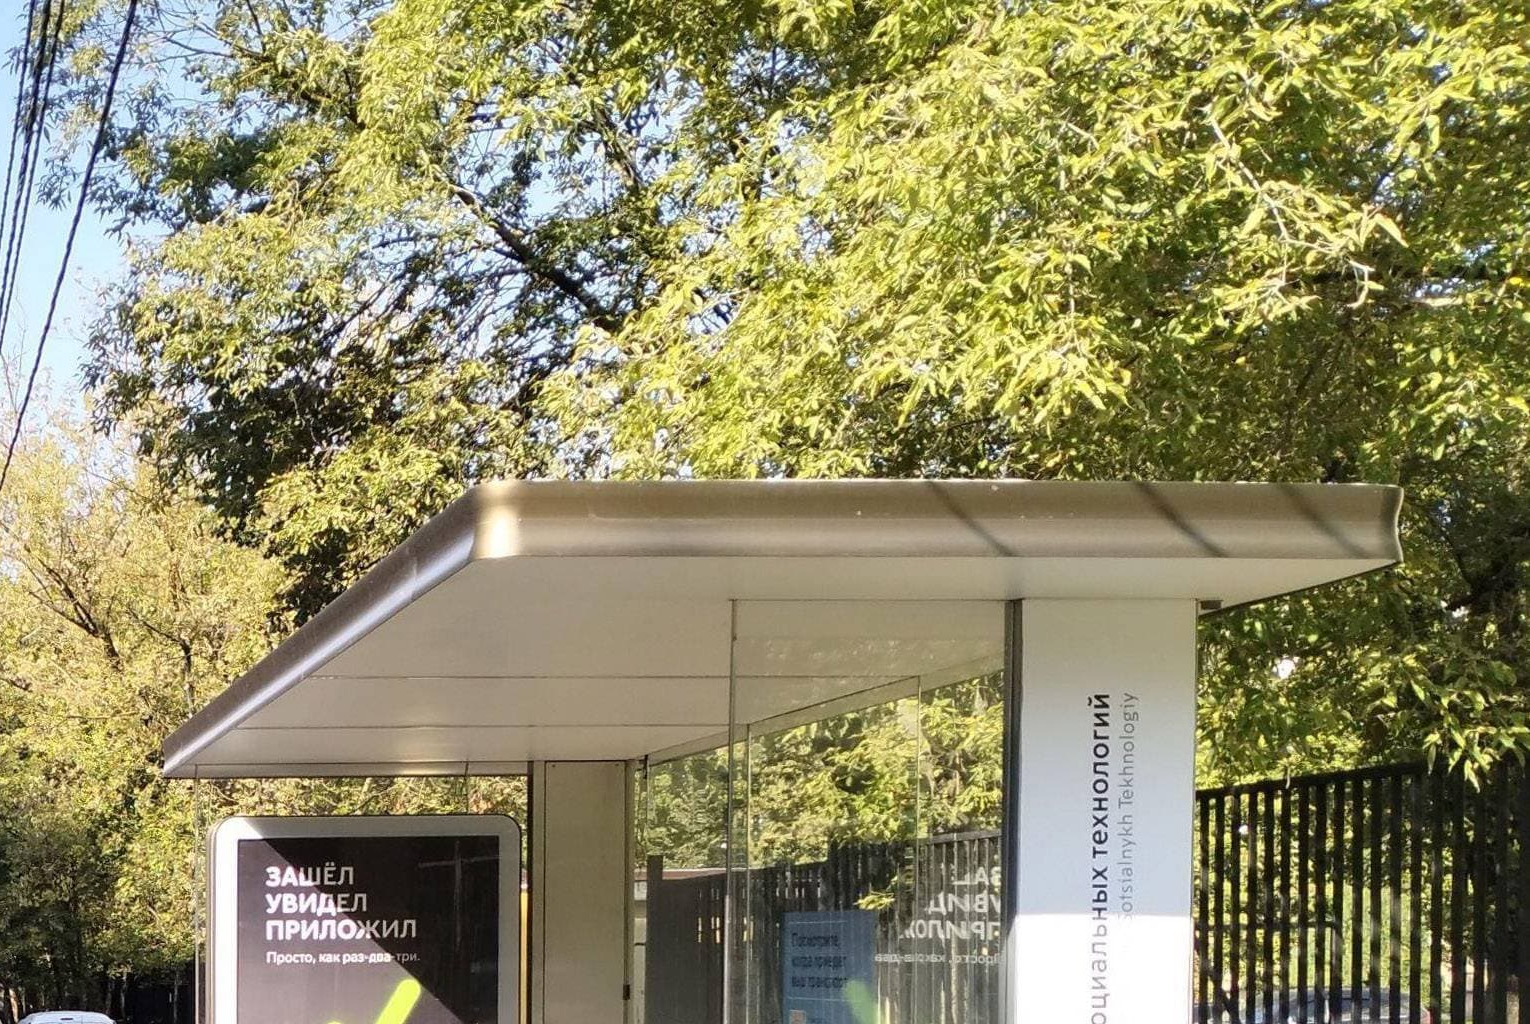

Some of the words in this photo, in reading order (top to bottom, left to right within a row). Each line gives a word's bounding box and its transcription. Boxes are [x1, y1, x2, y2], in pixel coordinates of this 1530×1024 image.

[1118, 692, 1139, 809] Tekhnologiy
[1087, 693, 1111, 859] технологий
[265, 861, 354, 887] ЗАШЁЛ
[265, 892, 367, 916] УВИДЕЛ
[265, 918, 417, 941] ПРИЛОЖИЛ
[266, 951, 316, 966] Просто,
[319, 952, 341, 963] как
[342, 952, 421, 966] раз-два-три.
